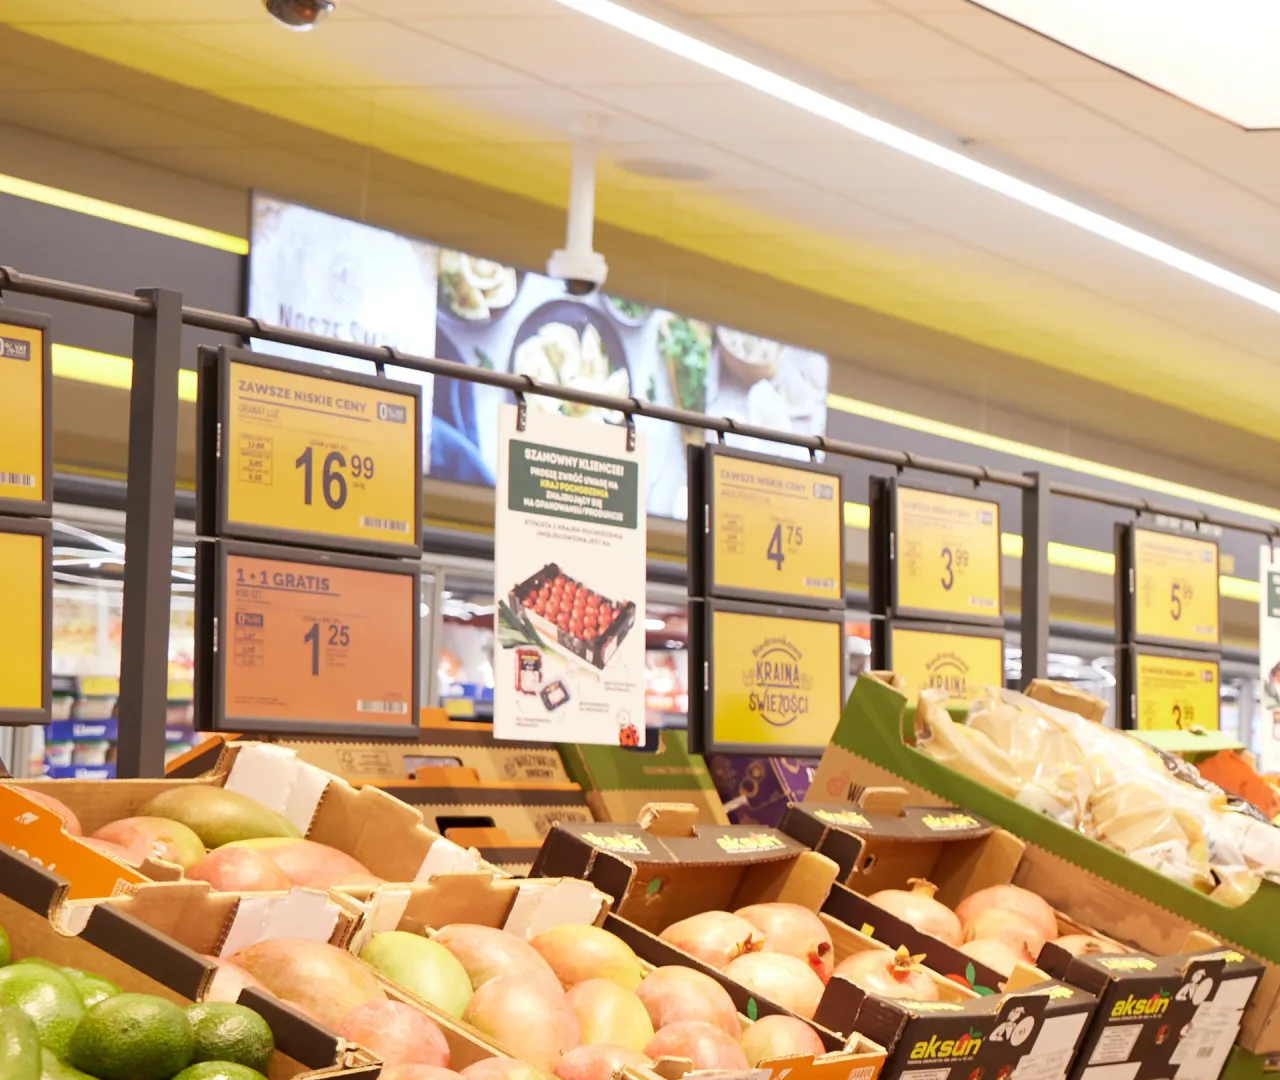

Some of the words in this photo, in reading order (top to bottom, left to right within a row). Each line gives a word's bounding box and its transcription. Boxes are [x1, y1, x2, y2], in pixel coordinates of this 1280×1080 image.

[238, 379, 292, 400] ZAWSZE
[294, 389, 334, 408] NISKIE
[335, 398, 368, 414] CENY
[295, 446, 348, 511] 16
[351, 454, 375, 480] 99
[524, 447, 579, 470] SZANOWNY
[578, 457, 625, 478] KLIENCIE!
[766, 523, 785, 572] 4
[786, 525, 803, 546] 75
[273, 571, 331, 592] GRATIS
[940, 546, 954, 591] 3
[1170, 583, 1182, 621] 5
[304, 623, 320, 677] 1
[327, 624, 351, 647] 25
[755, 660, 800, 685] KRAINA
[1111, 994, 1170, 1017] aksun
[909, 1033, 982, 1060] aksun
